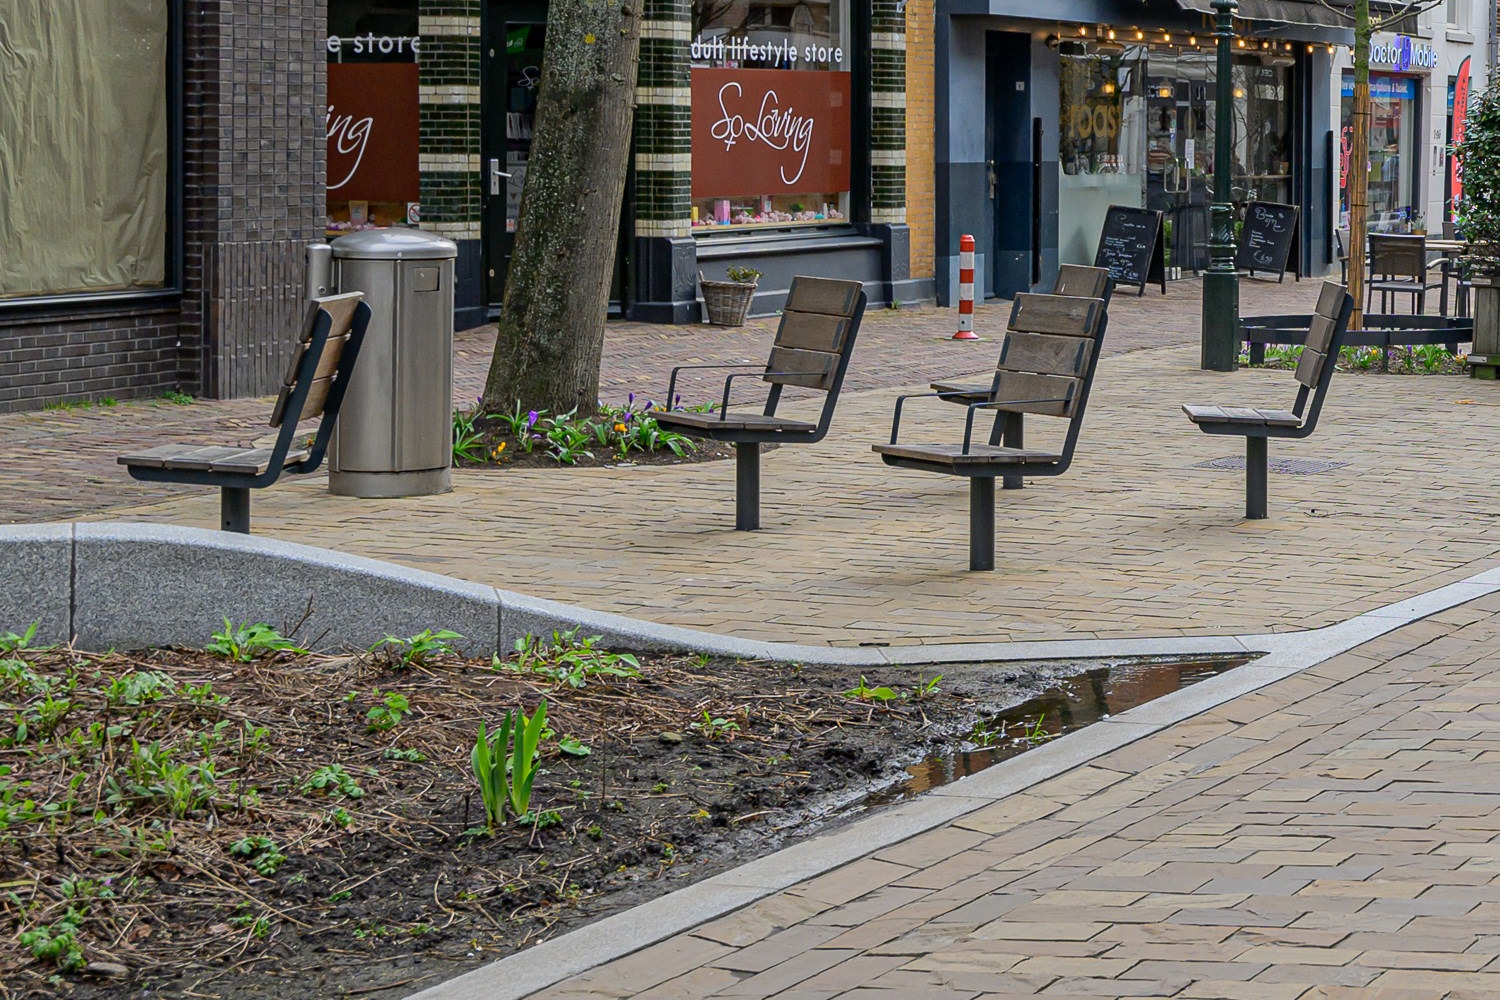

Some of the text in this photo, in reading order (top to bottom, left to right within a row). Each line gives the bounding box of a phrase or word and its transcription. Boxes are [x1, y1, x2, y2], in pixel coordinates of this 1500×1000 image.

[731, 36, 798, 67] lifestyle
[805, 43, 843, 62] store
[1410, 42, 1438, 67] Mobile
[711, 82, 814, 185] So Loving
